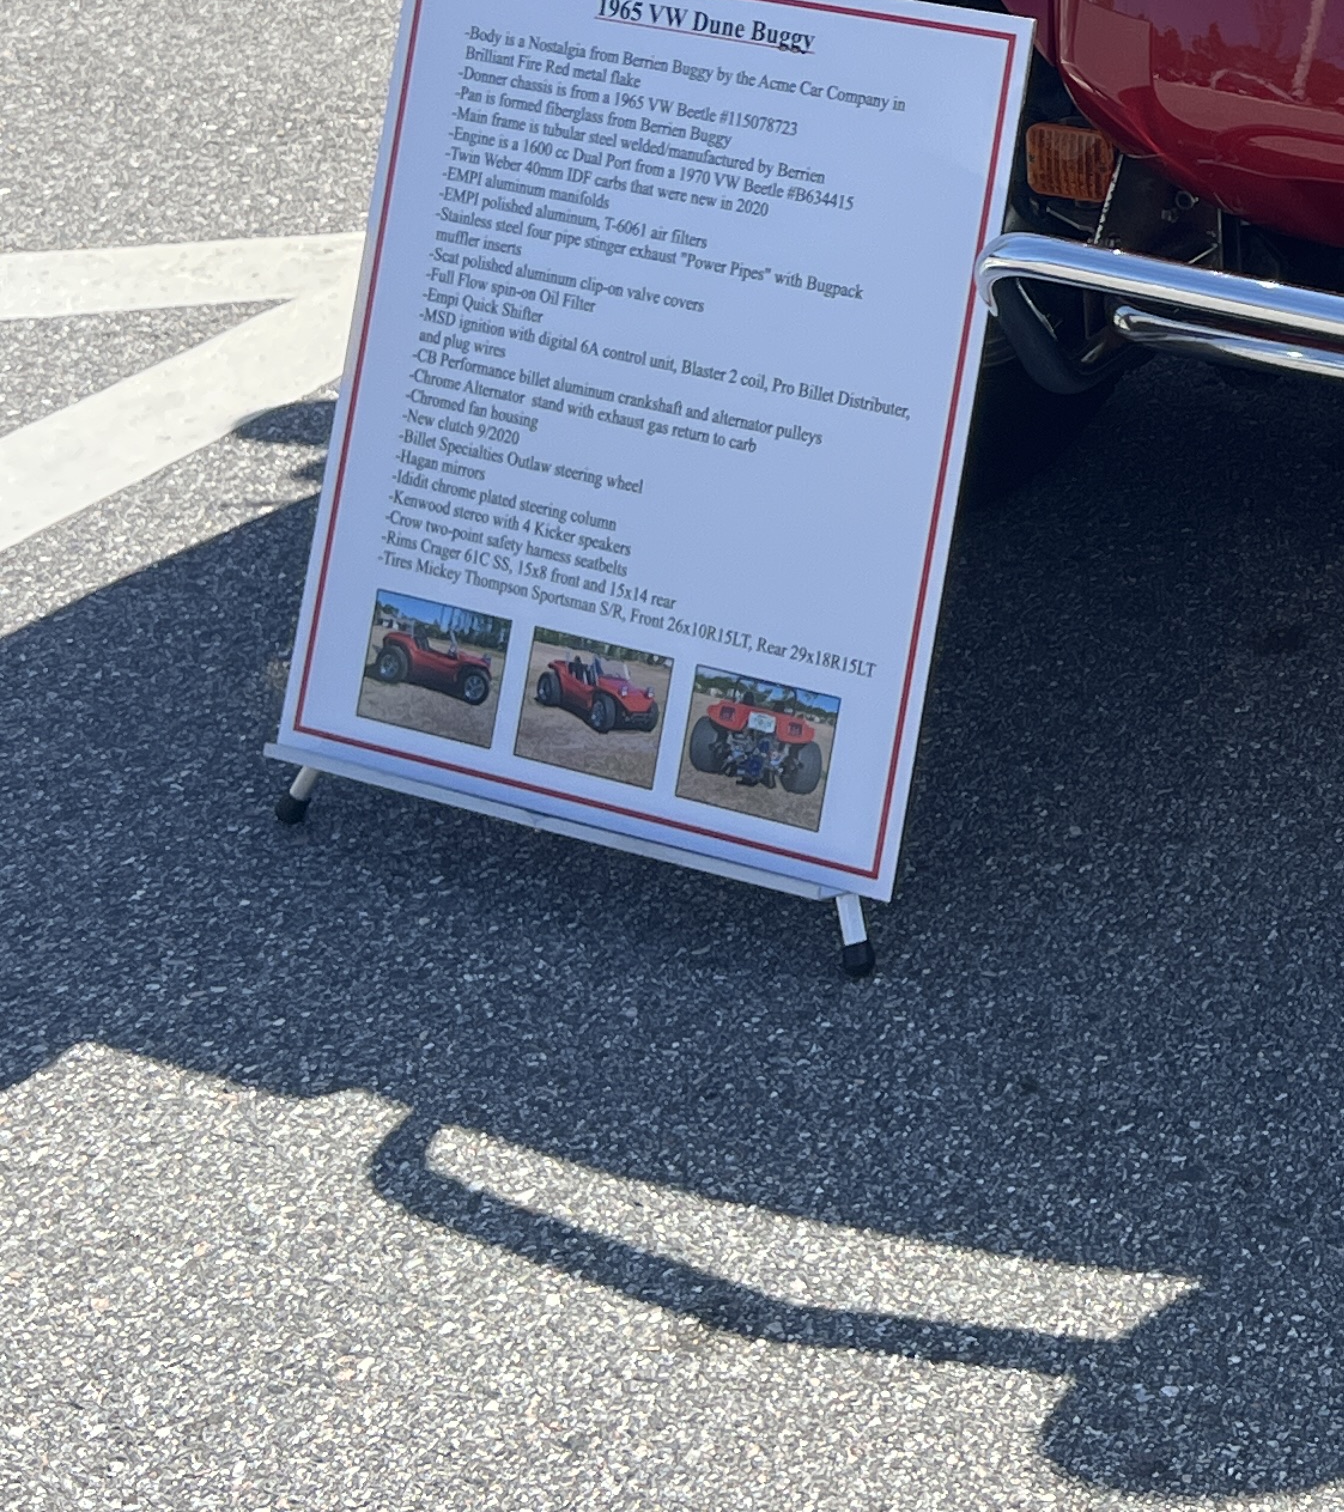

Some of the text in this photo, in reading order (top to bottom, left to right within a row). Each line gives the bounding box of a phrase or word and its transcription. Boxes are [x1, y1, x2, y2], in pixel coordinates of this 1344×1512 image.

[649, 3, 688, 28] VW
[691, 10, 746, 39] Dune
[749, 20, 816, 54] Buggy
[465, 45, 641, 89] Brilliant Fire Red metal flake
[504, 31, 515, 46] is
[517, 37, 525, 48] a
[528, 35, 586, 60] Nostalgia
[589, 45, 619, 64] from
[621, 51, 669, 72] Berrien
[671, 59, 714, 83] Buggy
[716, 66, 734, 86] by
[736, 70, 757, 87] the
[757, 74, 797, 94] Acme
[799, 80, 825, 98] Car
[826, 85, 890, 112] Company
[892, 96, 906, 112] in
[510, 74, 553, 95] chassis
[555, 81, 567, 97] is
[570, 84, 600, 103] from
[602, 93, 610, 104] a
[614, 92, 645, 110] 1965
[648, 97, 674, 114] VW
[676, 102, 717, 123] Beetle
[719, 110, 798, 136] #115078723
[491, 112, 527, 131] frame
[528, 123, 540, 134] is
[542, 122, 587, 142] tubular
[588, 132, 618, 148] steel
[620, 137, 755, 172] welded/manufactured
[757, 158, 774, 178] by
[776, 162, 825, 184] Berrien
[498, 134, 509, 149] is
[511, 140, 519, 151] a
[523, 138, 553, 157] 1600
[555, 148, 570, 160] cc
[572, 147, 603, 166] Dual
[604, 153, 632, 171] Port
[634, 158, 665, 178] from
[667, 168, 675, 179] a
[679, 166, 711, 185] 1970
[714, 172, 741, 190] VW
[742, 177, 785, 198] Beetle
[786, 186, 854, 211] #B634415
[484, 152, 523, 172] Weber
[524, 160, 564, 180] 40mm
[566, 167, 593, 185] IDF
[594, 175, 627, 192] carbs
[630, 179, 654, 196] that
[657, 187, 688, 203] were
[690, 193, 718, 207] new
[720, 195, 733, 211] in
[735, 198, 769, 217] 2020
[484, 174, 546, 198] aluminum
[548, 189, 610, 209] manifolds
[435, 230, 522, 256] muffler inserts
[495, 220, 524, 235] steel
[526, 223, 553, 241] four
[553, 229, 582, 248] pipe
[584, 237, 627, 256] stinger
[629, 244, 677, 264] exhaust
[680, 252, 728, 274] "Power
[729, 261, 772, 282] Pipes"
[774, 272, 803, 288] with
[806, 275, 864, 300] Bugpack
[457, 272, 489, 291] Flow
[490, 283, 536, 301] spin-on
[539, 288, 560, 306] Oil
[562, 293, 597, 313] Filter
[462, 294, 499, 315] Quick
[501, 302, 544, 323] Shifter
[419, 330, 506, 358] and plug wires
[458, 314, 505, 337] ignition
[509, 326, 536, 343] with
[538, 331, 578, 352] digital
[580, 339, 599, 357] 6A
[602, 347, 647, 366] control
[649, 356, 677, 374] unit,
[680, 359, 727, 382] Blaster
[728, 368, 738, 384] 2
[740, 373, 768, 393] coil,
[771, 377, 795, 395] Pro
[797, 382, 834, 403] Billet
[836, 390, 910, 421] Distributer,
[437, 416, 474, 436] clutch
[477, 423, 520, 445] 9/2020
[440, 461, 486, 481] mirrors
[420, 538, 462, 561] Crager
[492, 554, 513, 575] SS,
[518, 560, 548, 580] 15x8
[550, 567, 580, 588] front
[582, 578, 607, 594] and
[610, 581, 648, 603] 15x14
[650, 595, 677, 610] rear
[415, 557, 462, 584] Mickey
[464, 569, 528, 598] Thompson
[531, 584, 596, 613] Sportsman
[599, 600, 626, 622] S/R,
[630, 607, 664, 629] Front
[666, 616, 753, 653] 26x10R15LT,
[755, 637, 788, 658] Rear
[789, 644, 877, 678] 29x18R15LT
